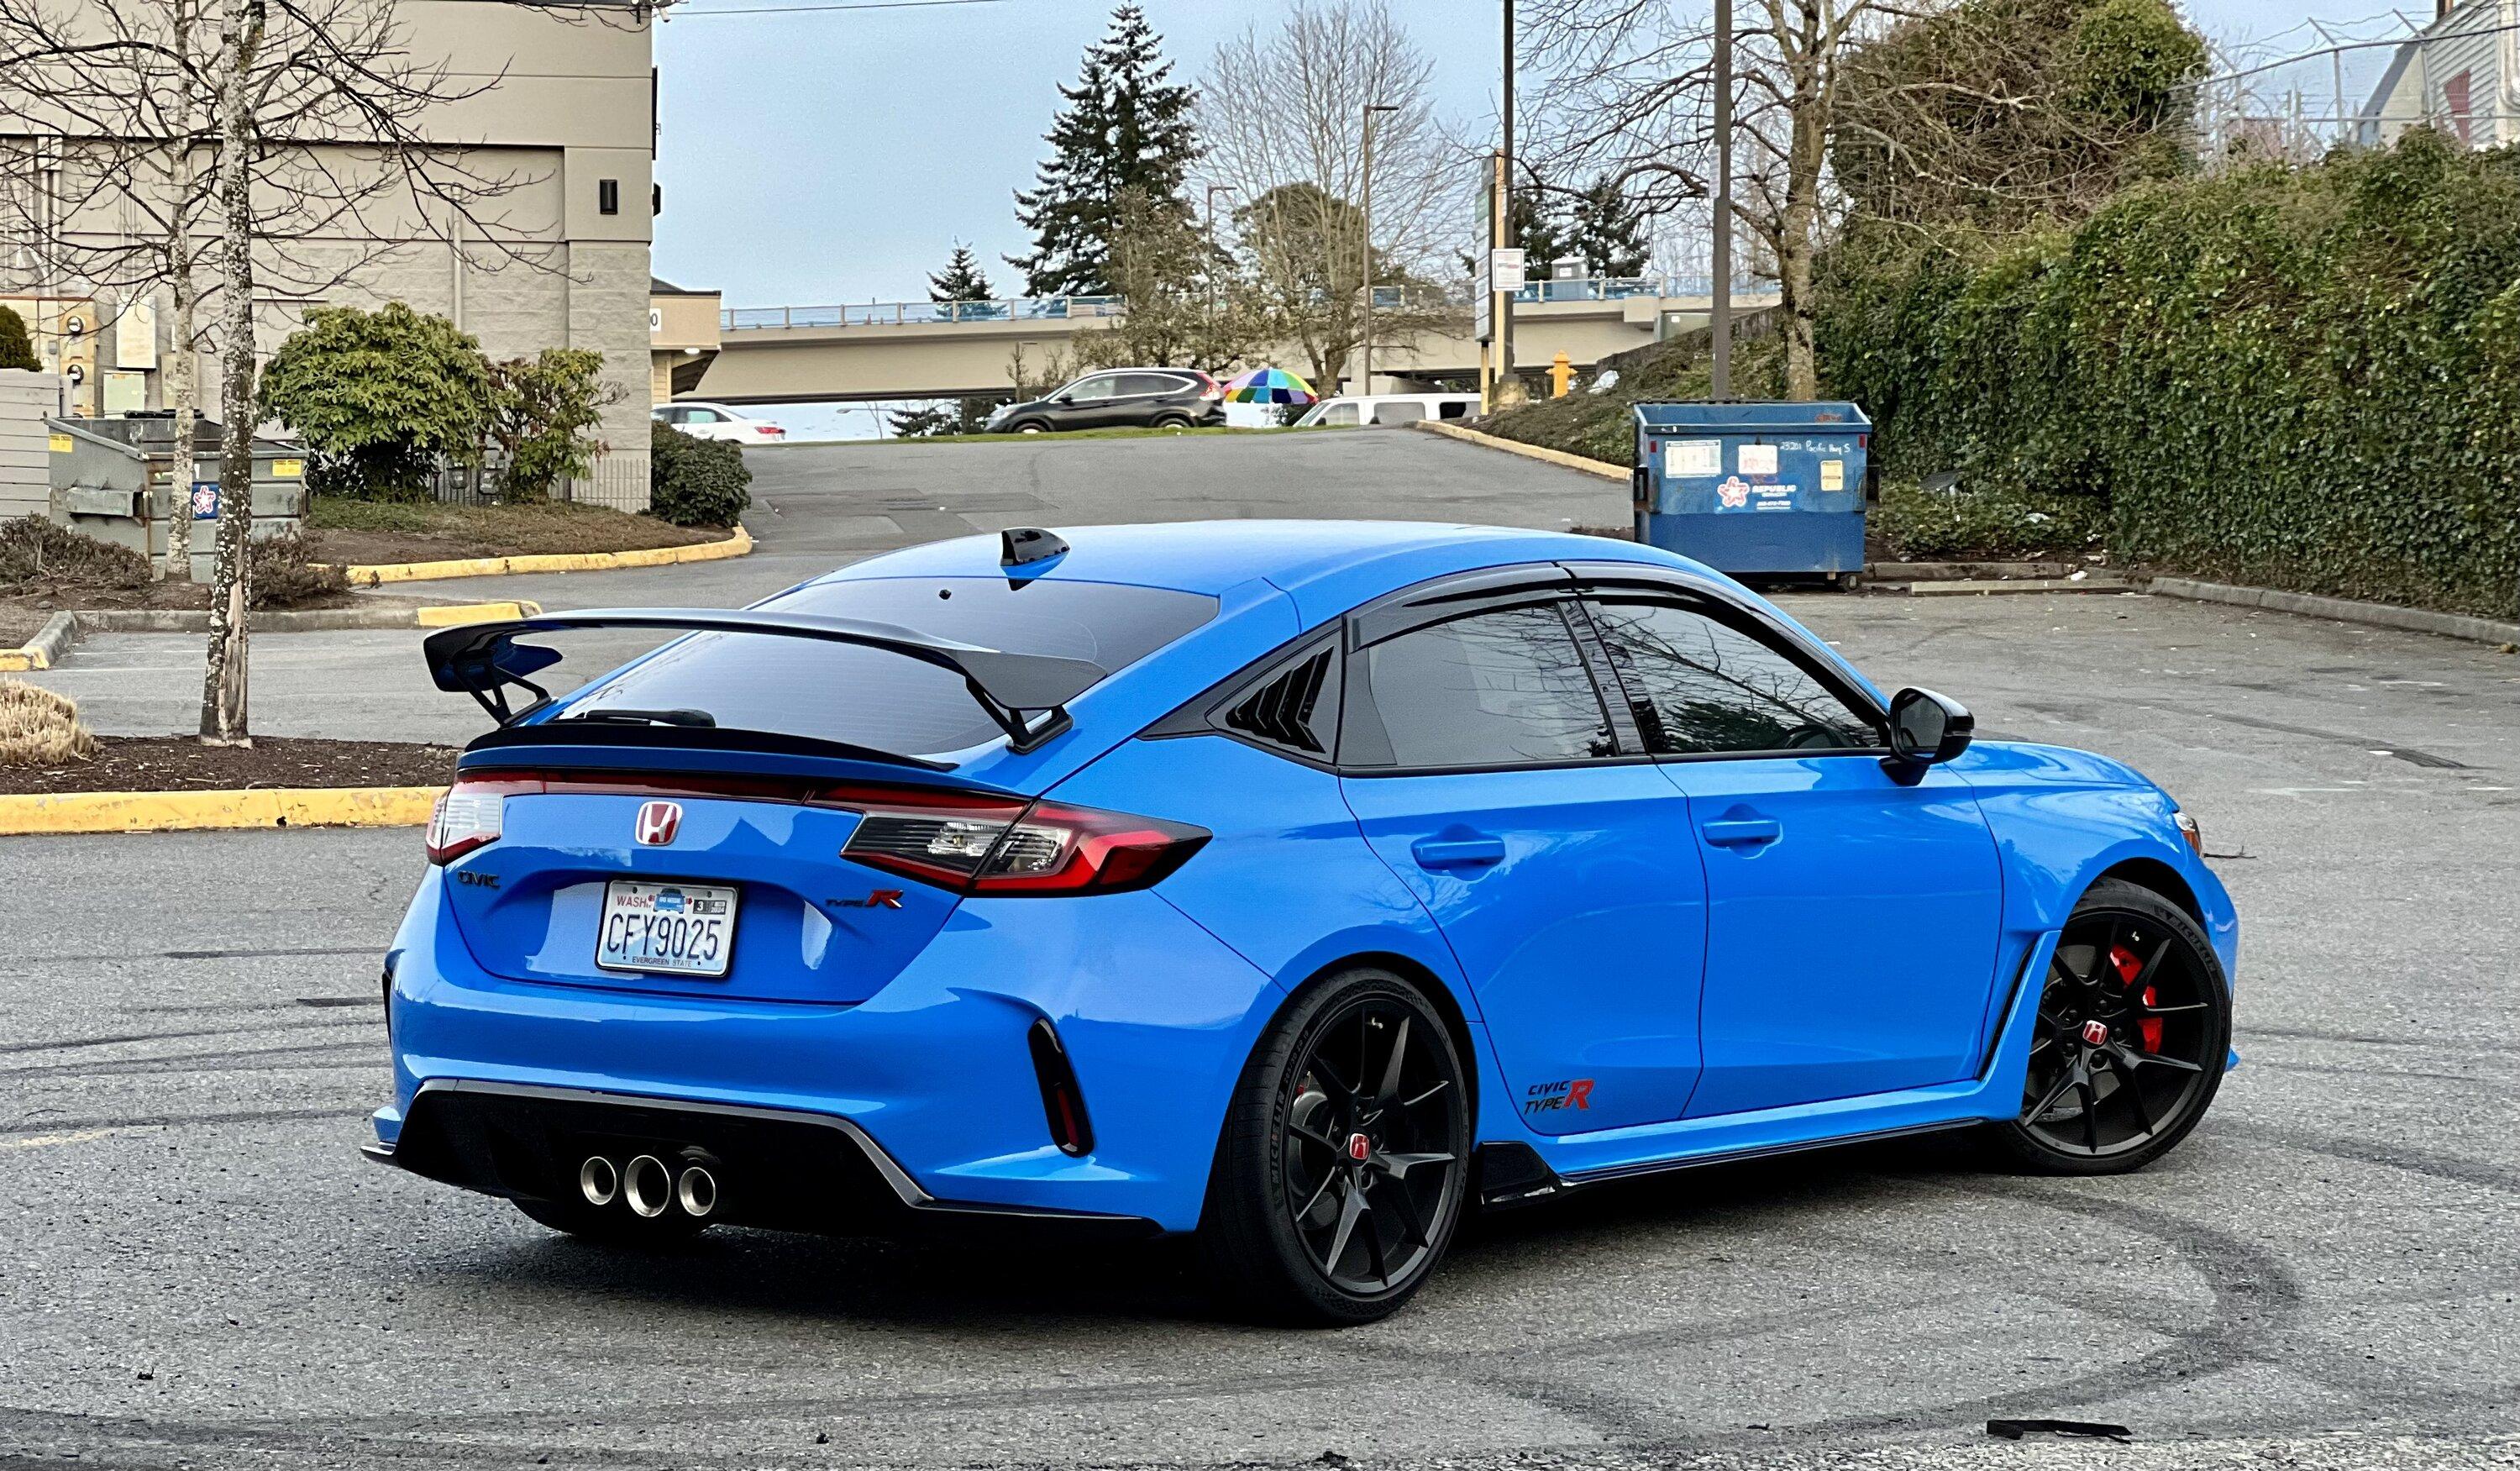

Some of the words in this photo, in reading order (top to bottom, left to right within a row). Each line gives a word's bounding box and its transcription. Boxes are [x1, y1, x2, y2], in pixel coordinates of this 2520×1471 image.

[1844, 443, 1851, 453] S
[458, 870, 501, 888] CIVIC
[696, 901, 704, 911] 3
[866, 890, 904, 909] R
[606, 913, 721, 960] CFY9025
[632, 956, 669, 965] EVERGREEN
[673, 959, 692, 967] STATE
[1528, 1080, 1572, 1095] CIVIC
[1524, 1096, 1565, 1115] TYPE
[1563, 1080, 1594, 1110] R
